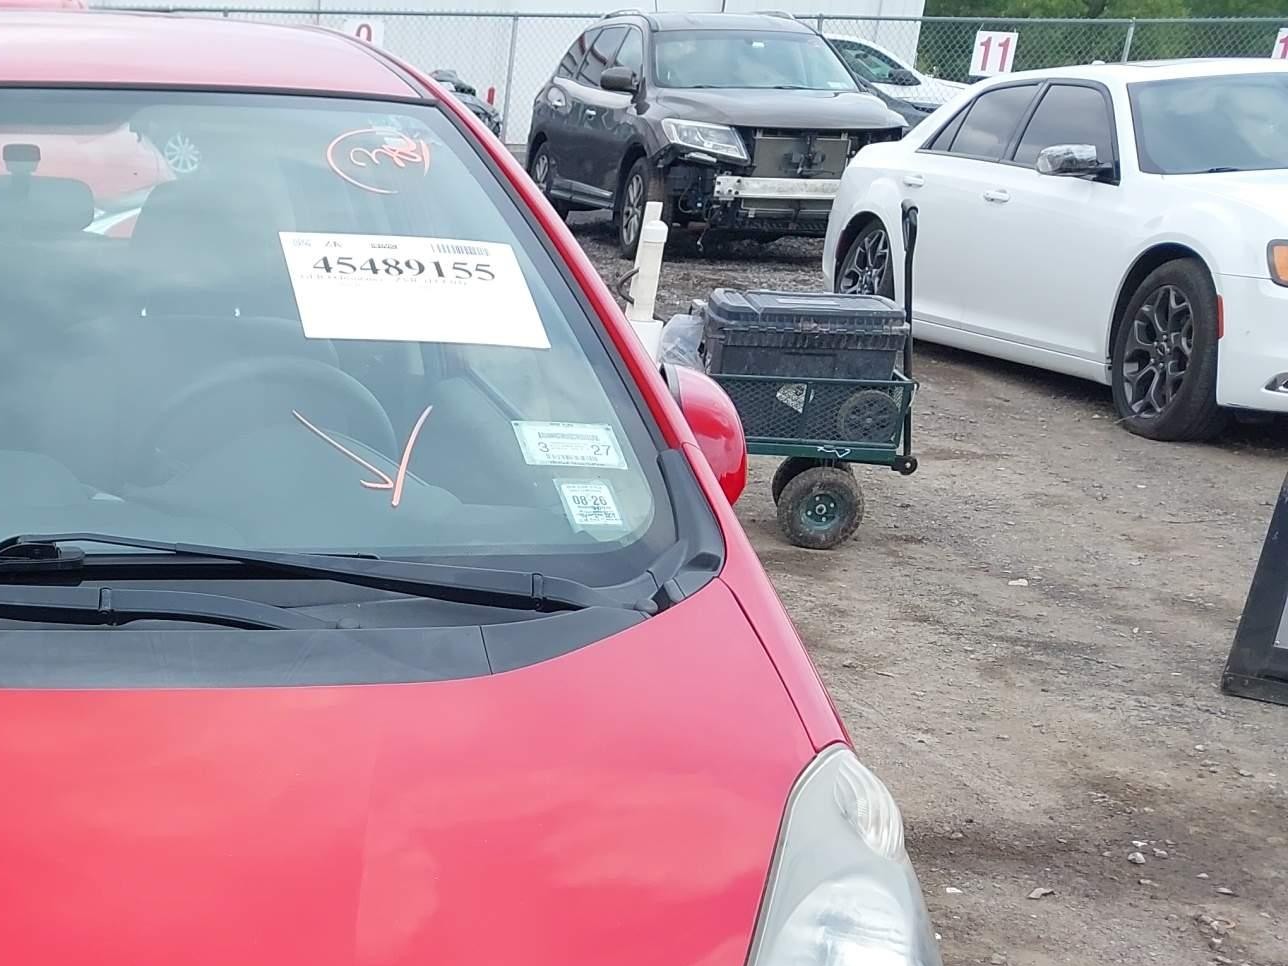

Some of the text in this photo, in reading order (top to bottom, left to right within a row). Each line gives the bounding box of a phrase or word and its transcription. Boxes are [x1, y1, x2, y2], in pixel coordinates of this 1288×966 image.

[980, 36, 1010, 72] 11
[312, 256, 496, 281] 45489155
[537, 441, 550, 453] 3
[590, 444, 611, 456] 27
